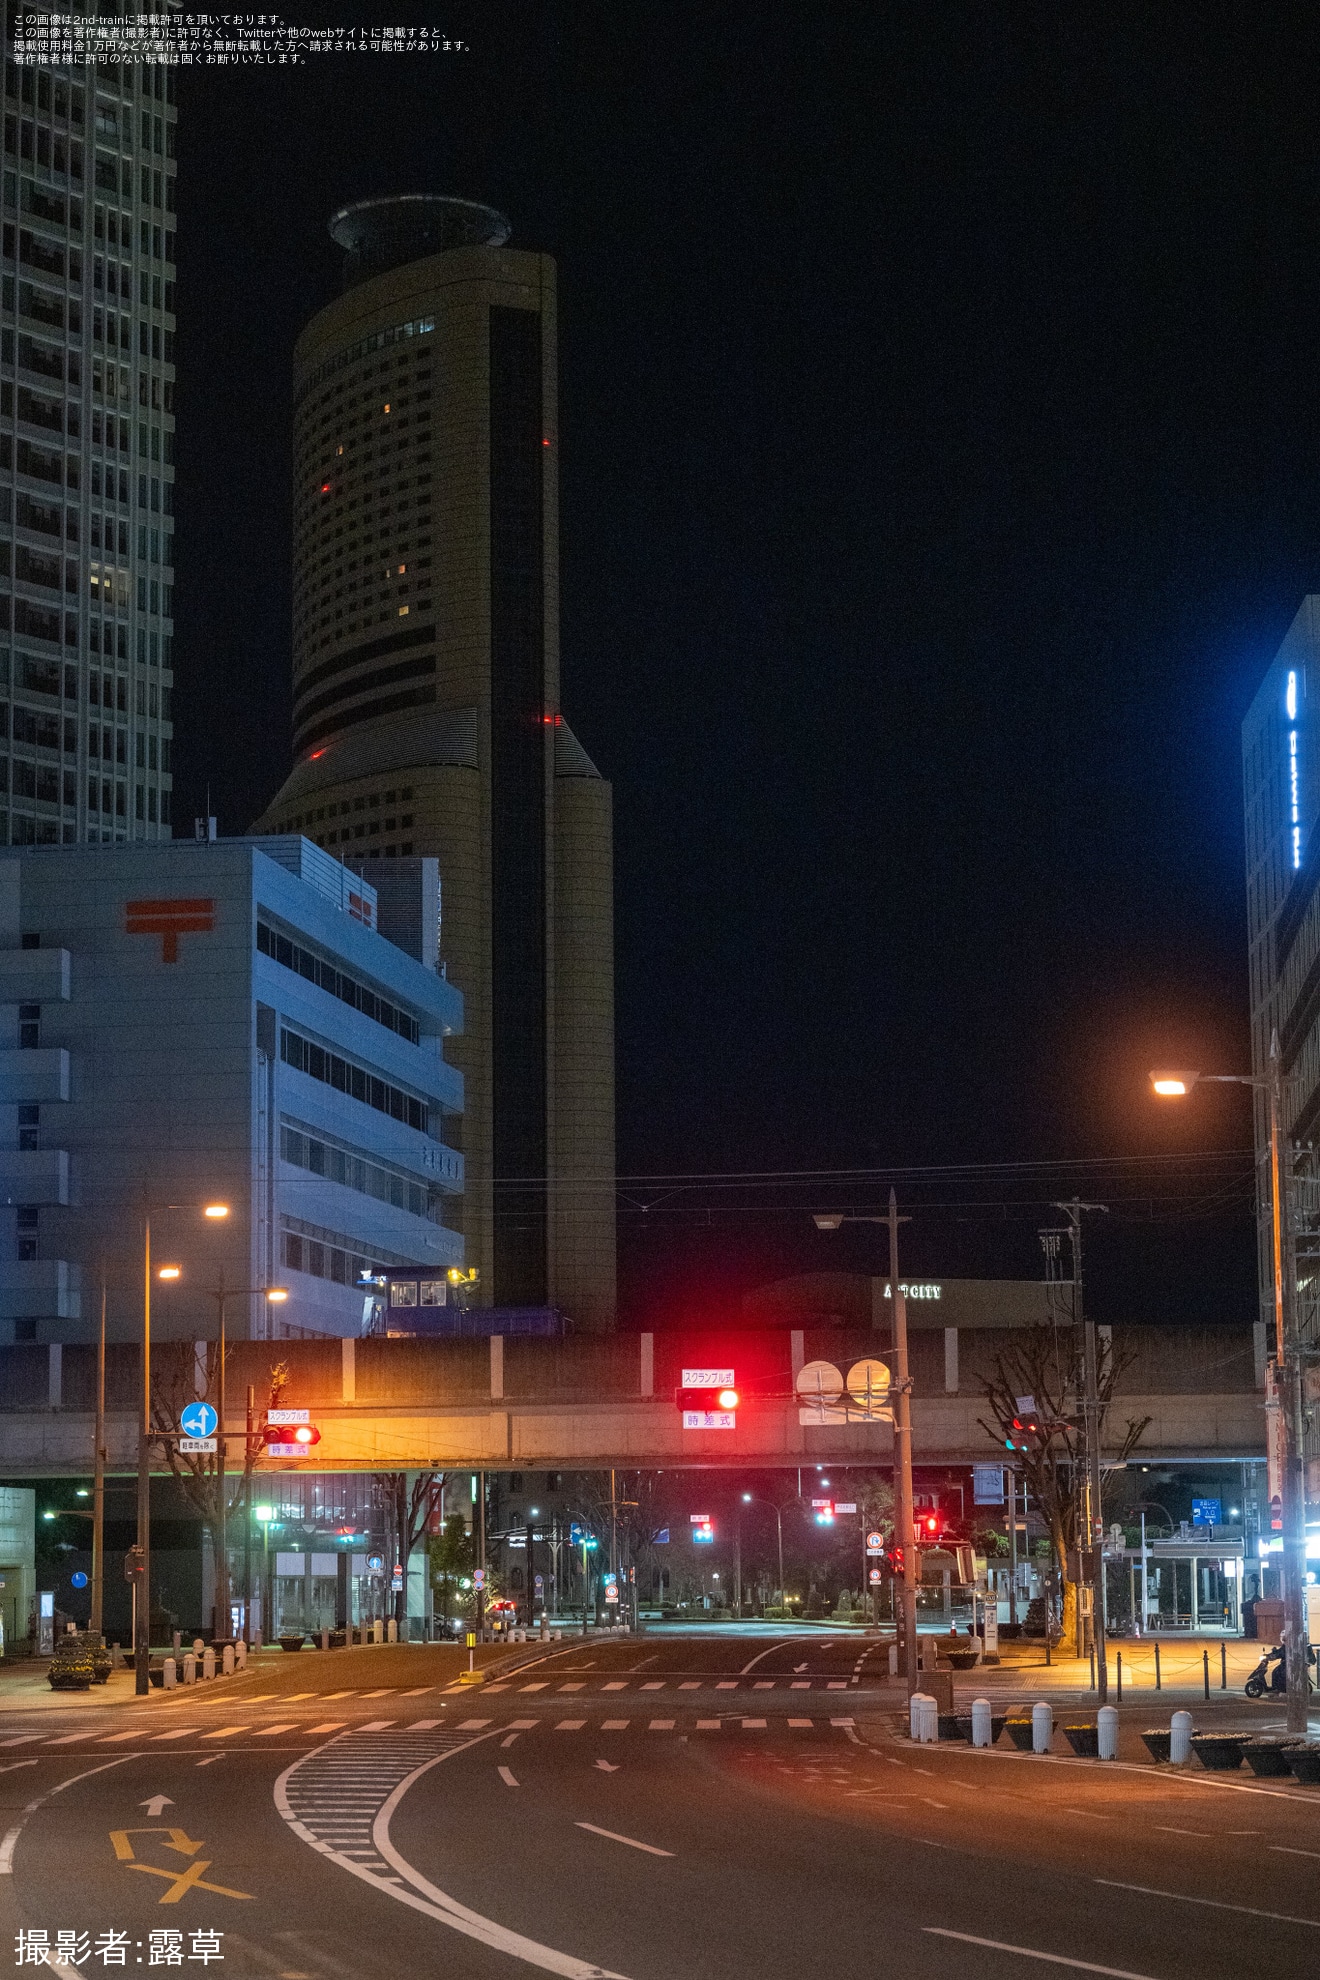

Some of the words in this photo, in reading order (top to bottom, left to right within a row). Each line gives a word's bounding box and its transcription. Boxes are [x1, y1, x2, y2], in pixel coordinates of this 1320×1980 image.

[910, 1285, 941, 1299] CITY
[685, 1372, 733, 1383] スクランブル式
[270, 1411, 308, 1420] スクランブル式
[687, 1414, 731, 1426] 時差式
[271, 1445, 307, 1454] 時差式
